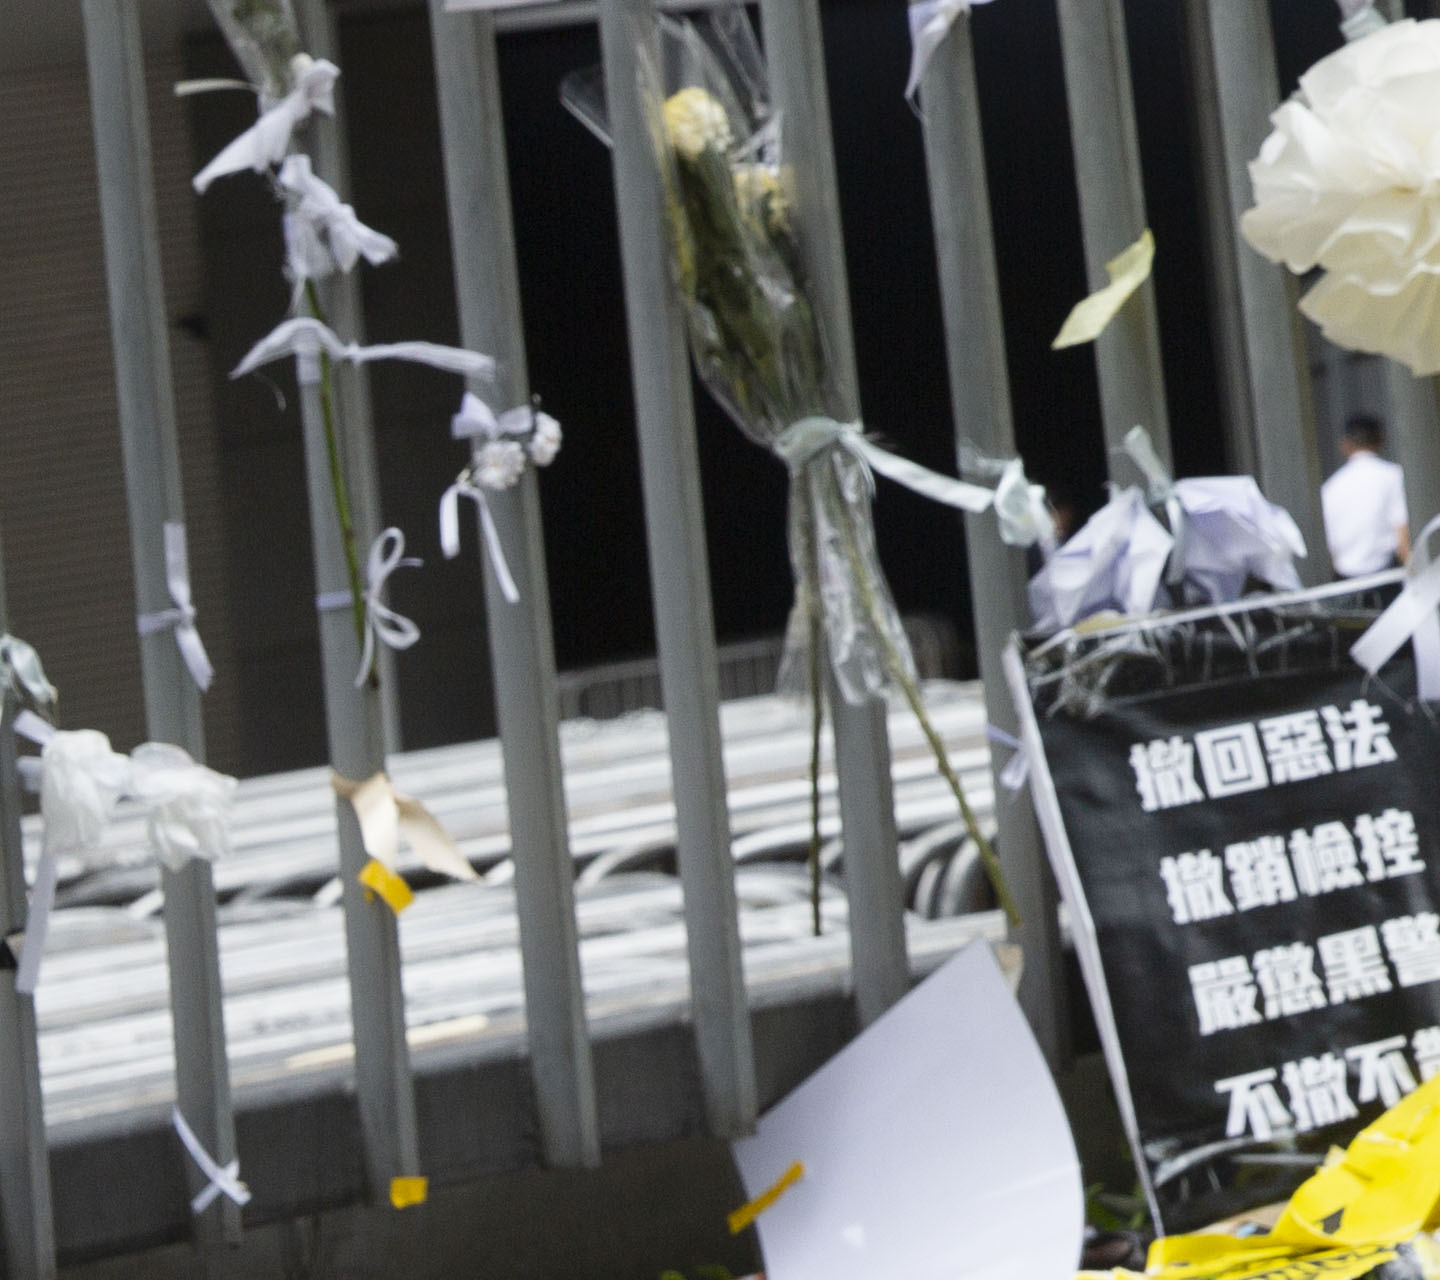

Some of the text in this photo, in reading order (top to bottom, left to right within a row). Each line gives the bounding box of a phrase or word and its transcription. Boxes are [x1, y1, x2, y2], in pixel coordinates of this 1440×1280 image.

[1128, 698, 1397, 813] 撤回惡法
[1158, 807, 1427, 926] 撤銷檢控
